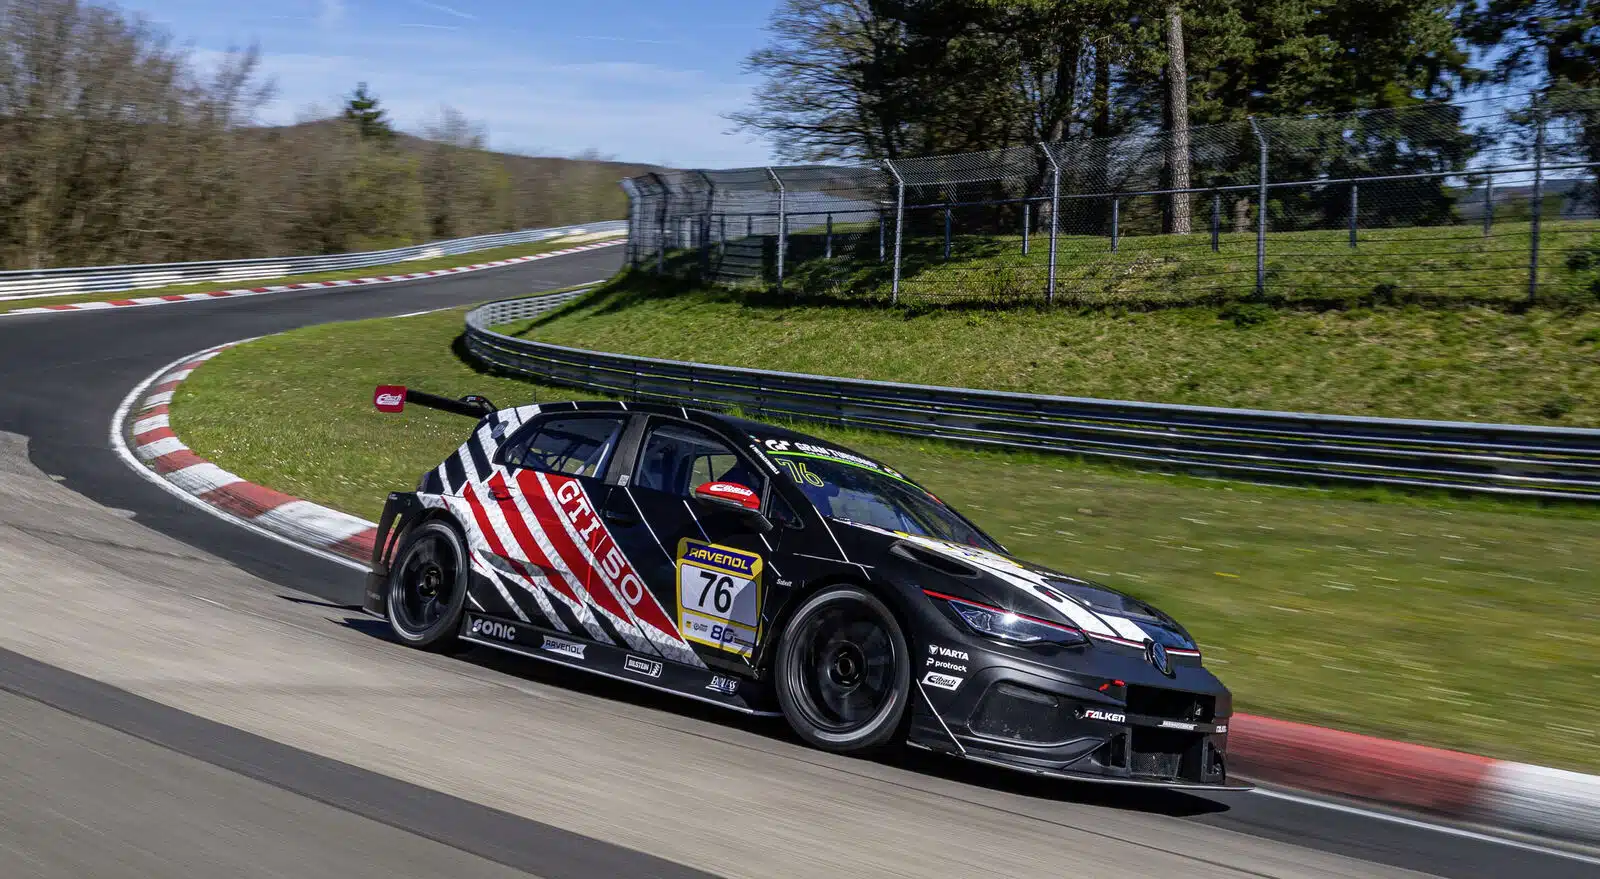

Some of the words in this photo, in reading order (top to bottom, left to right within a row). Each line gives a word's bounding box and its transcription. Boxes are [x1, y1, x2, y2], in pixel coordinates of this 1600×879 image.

[794, 442, 830, 456] GRAN
[774, 457, 824, 487] 76
[556, 480, 601, 542] GTI
[601, 546, 643, 606] 50
[689, 547, 749, 570] RAVENOL
[698, 570, 734, 613] 76
[546, 640, 581, 655] RAVENOL
[939, 647, 969, 661] VARTA
[628, 659, 649, 671] BILSTEIN
[935, 660, 967, 672] protrack
[927, 675, 956, 686] Eibach
[1084, 710, 1126, 723] FALKEN
